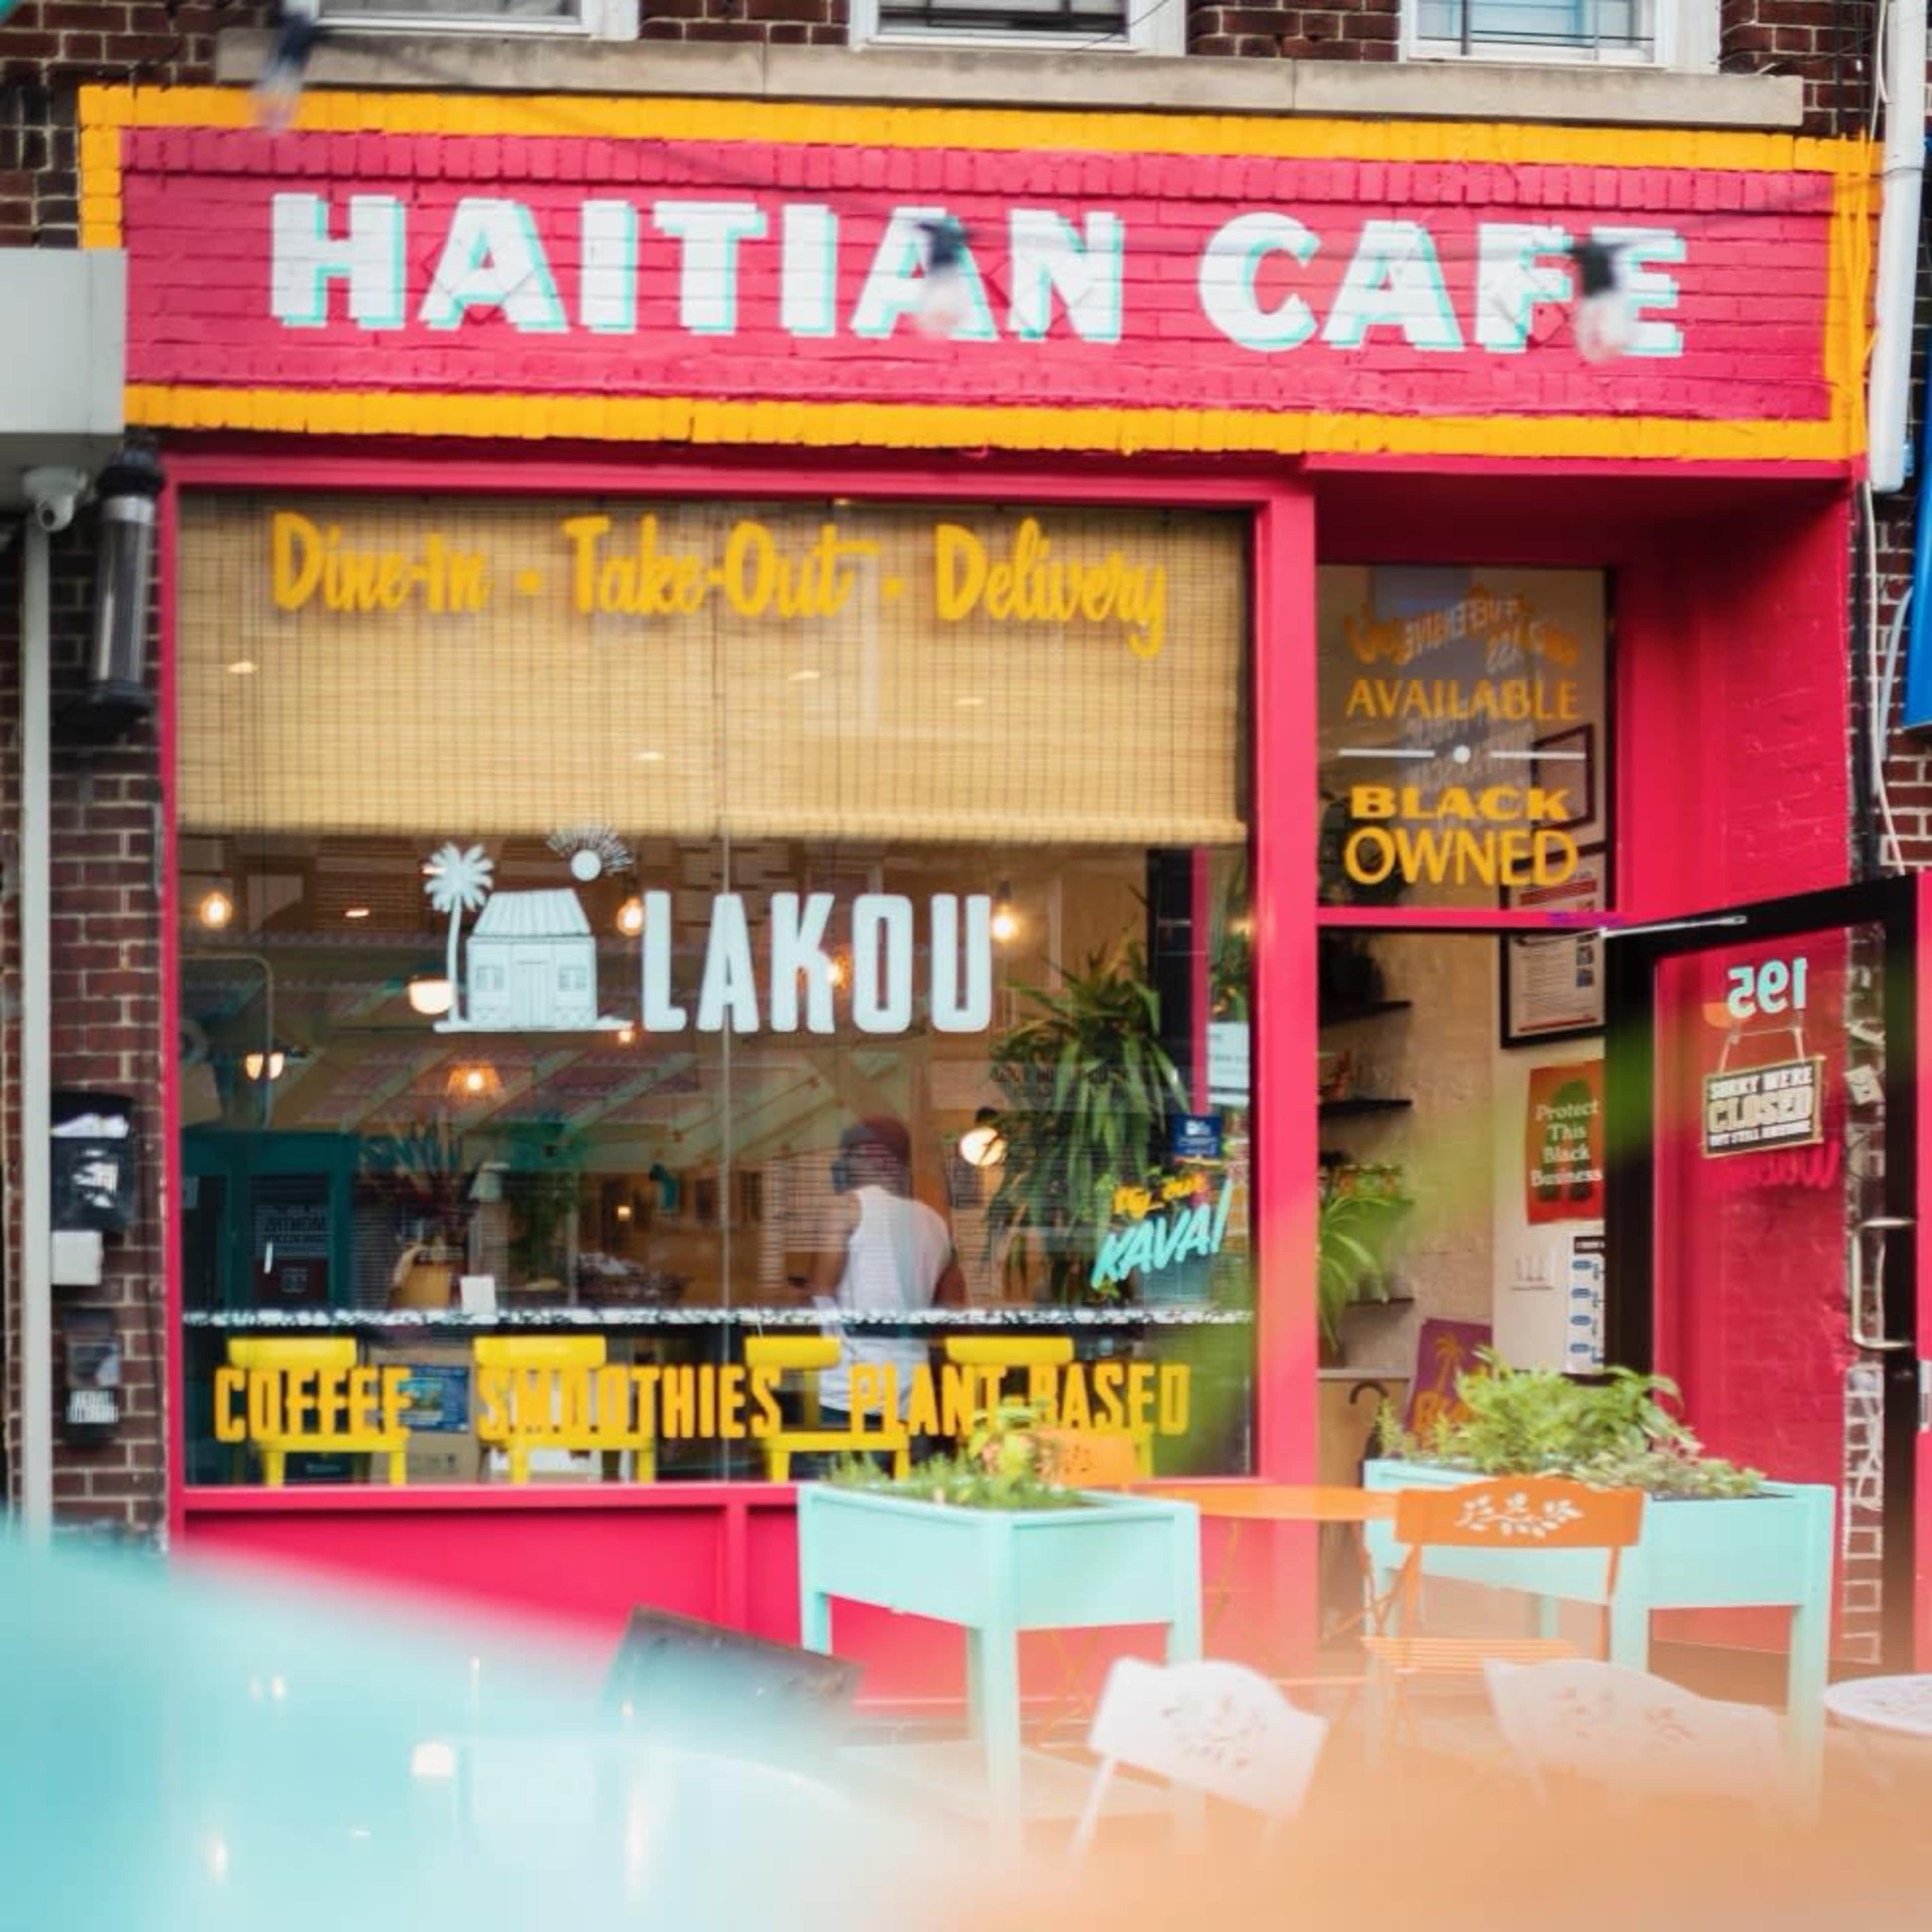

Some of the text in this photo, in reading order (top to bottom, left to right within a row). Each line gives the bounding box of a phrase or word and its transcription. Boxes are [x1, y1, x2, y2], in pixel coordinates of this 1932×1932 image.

[271, 193, 1686, 358] HAITIAN CAFE
[269, 510, 1167, 660] Dine-In Take-Out Delivery
[1345, 678, 1580, 720] AVAILABLE
[1351, 784, 1570, 821] BLACK
[1344, 826, 1579, 887] OWNED
[643, 889, 991, 1033] LAKOU
[1536, 1099, 1599, 1121] Protect
[1548, 1123, 1587, 1141] This
[1708, 1086, 1814, 1133] CLOSED
[1543, 1144, 1590, 1163] Black
[214, 1366, 413, 1442] COFFEE
[476, 1363, 782, 1440] SMOOTHIES
